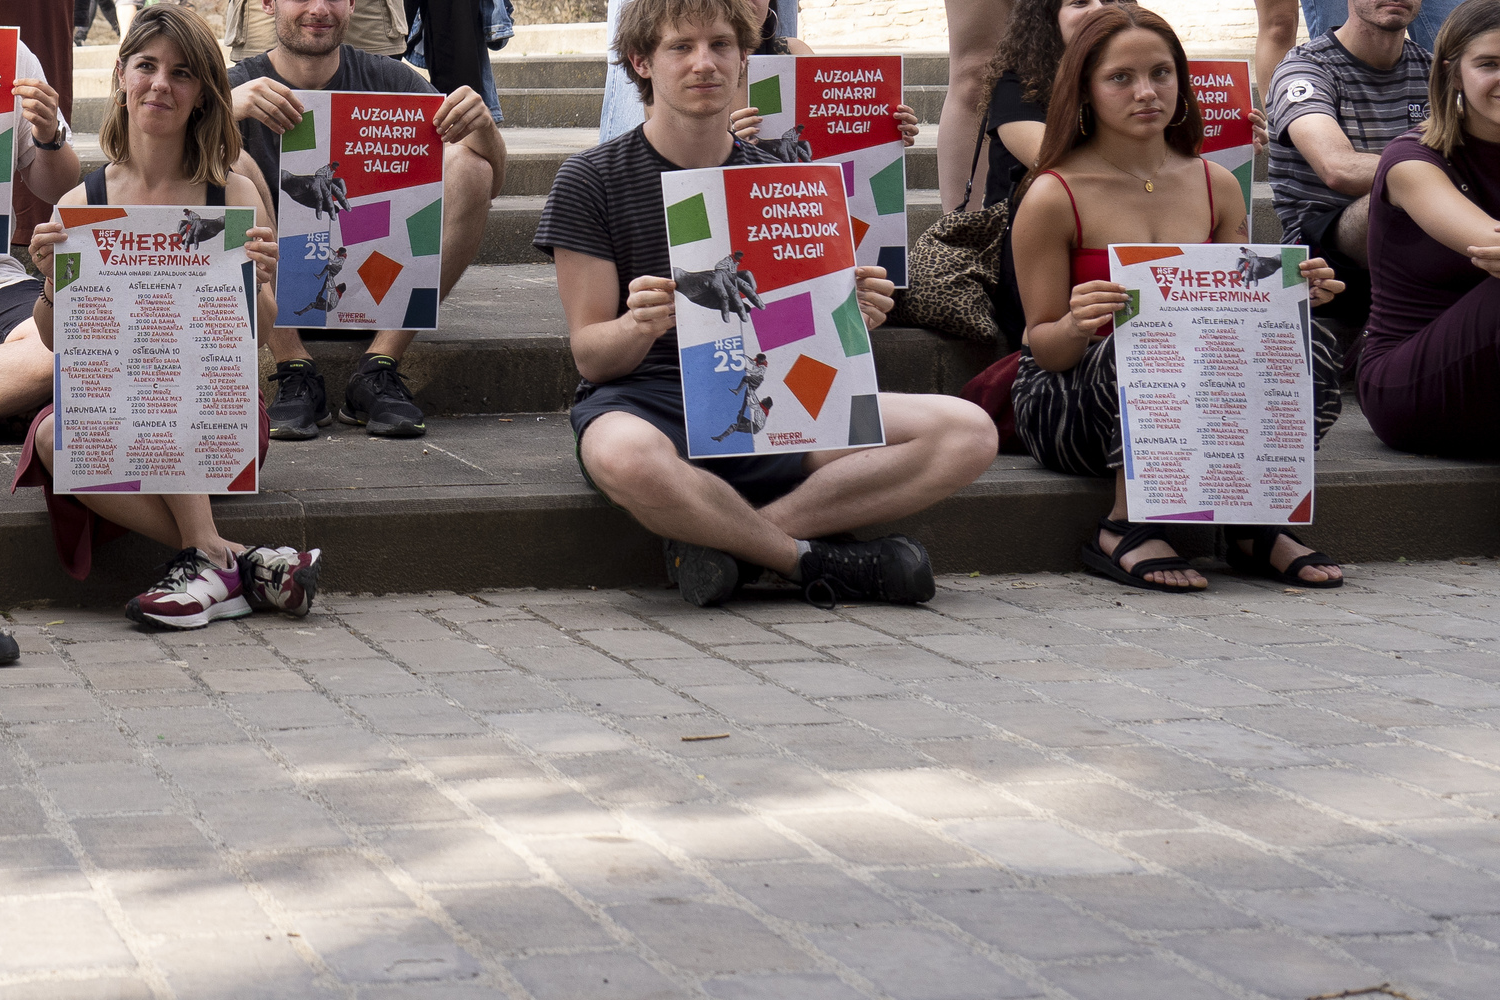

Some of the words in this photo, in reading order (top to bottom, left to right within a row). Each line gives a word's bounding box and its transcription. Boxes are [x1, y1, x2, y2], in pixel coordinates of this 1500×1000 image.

[815, 69, 883, 83] AUZOLANA
[823, 86, 875, 100] OINARRI
[351, 107, 424, 122] AUZOLANA
[809, 104, 888, 117] ZAPALDUOK
[360, 125, 415, 139] OINARRI
[828, 120, 870, 133] JALGI!
[345, 141, 429, 155] ZAPALDUOK
[364, 159, 409, 173] JALGI!
[750, 181, 828, 198] AUZOLANA
[763, 202, 823, 218] OINARRI
[748, 222, 839, 241] ZAPALDUOK
[98, 237, 116, 250] 25
[304, 242, 330, 260] 25
[773, 243, 824, 260] JALGI!
[111, 253, 210, 266] SANFERMINAK
[129, 281, 176, 289] ASTELEHENA
[1156, 275, 1175, 287] 25
[196, 284, 236, 292] ASTEARTEA
[1171, 290, 1270, 302] SANFERMINAK
[64, 347, 112, 355] ASTEAZKENA
[132, 346, 170, 354] OSTEGUNA
[201, 354, 233, 362] OSTIRALA
[713, 349, 745, 372] 25
[191, 421, 238, 430] ASTELEHENA
